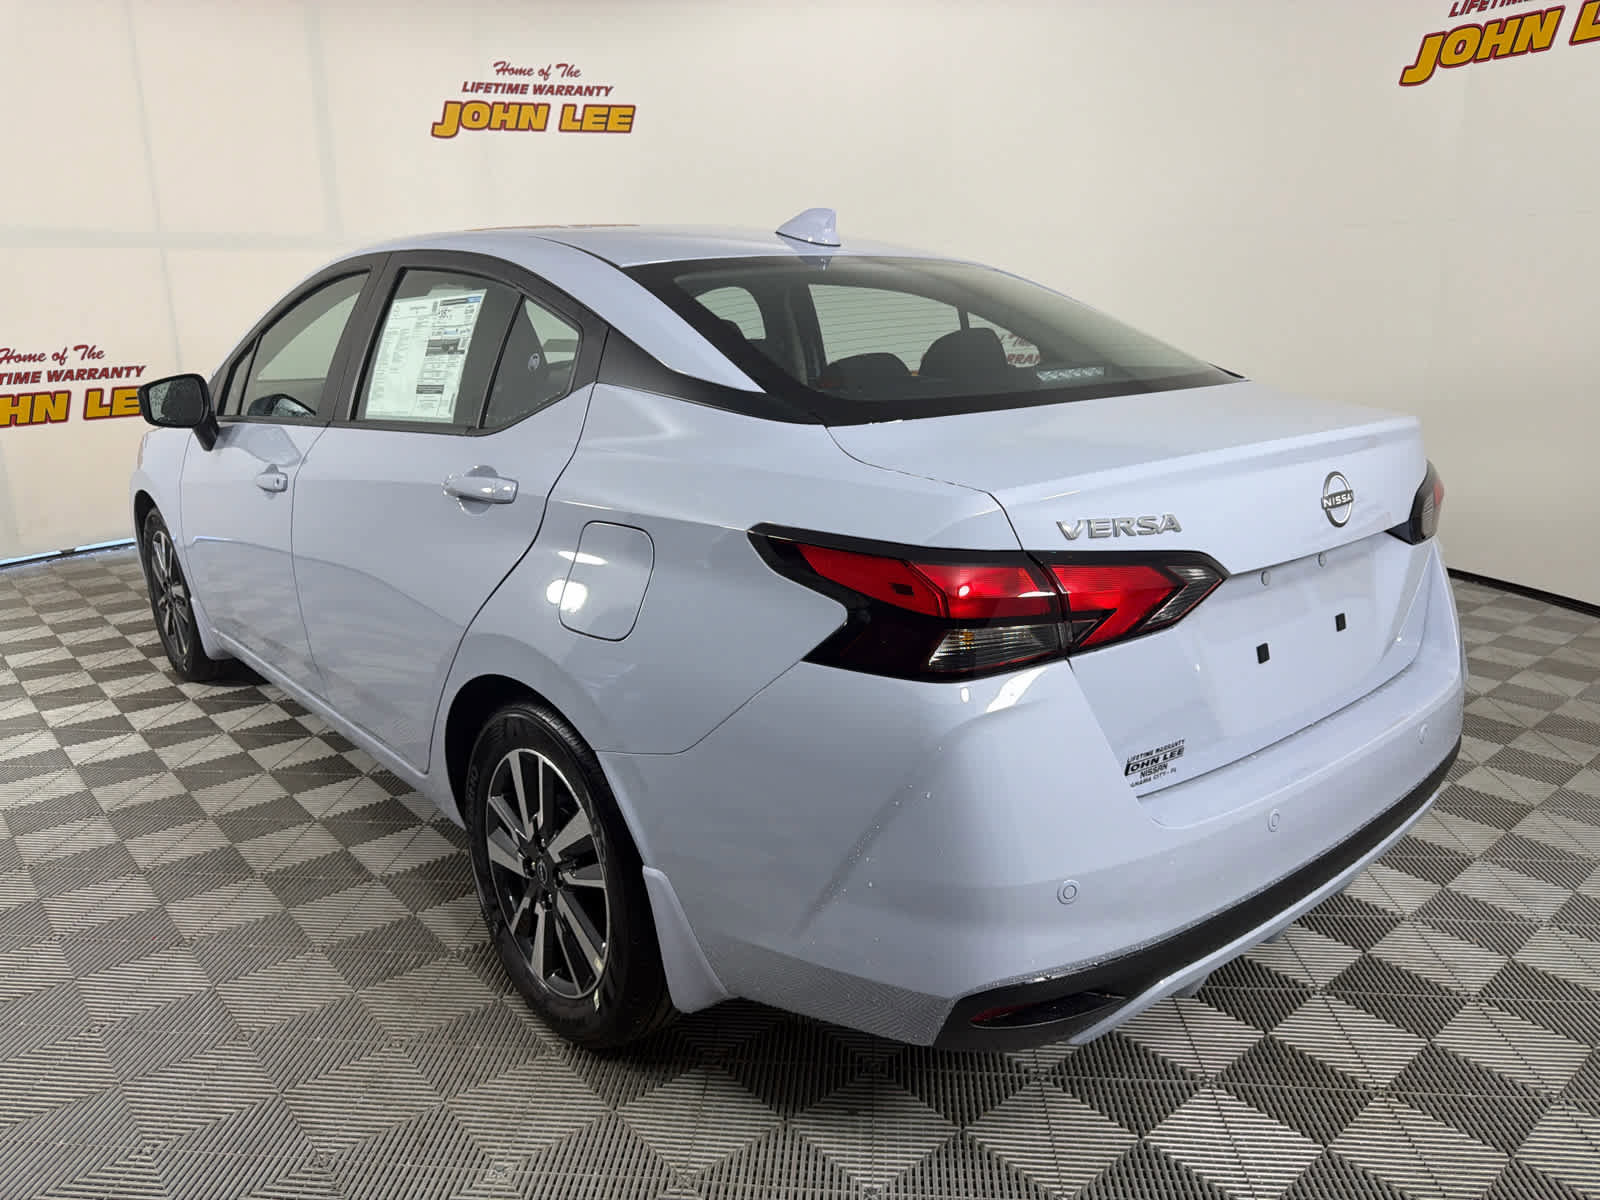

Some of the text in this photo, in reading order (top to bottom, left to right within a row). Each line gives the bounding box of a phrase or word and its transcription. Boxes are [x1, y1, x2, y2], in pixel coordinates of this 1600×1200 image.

[1399, 5, 1566, 87] JOHN
[493, 61, 582, 81] Home of The
[462, 81, 614, 97] LIFETIME WARRANTY
[431, 100, 636, 139] JOHN LEE
[0, 344, 105, 366] Home of The
[47, 365, 146, 383] WARRANTY
[1056, 513, 1183, 541] VERSA
[1124, 747, 1185, 777] JOHN LEE
[1140, 763, 1168, 779] NISSAN
